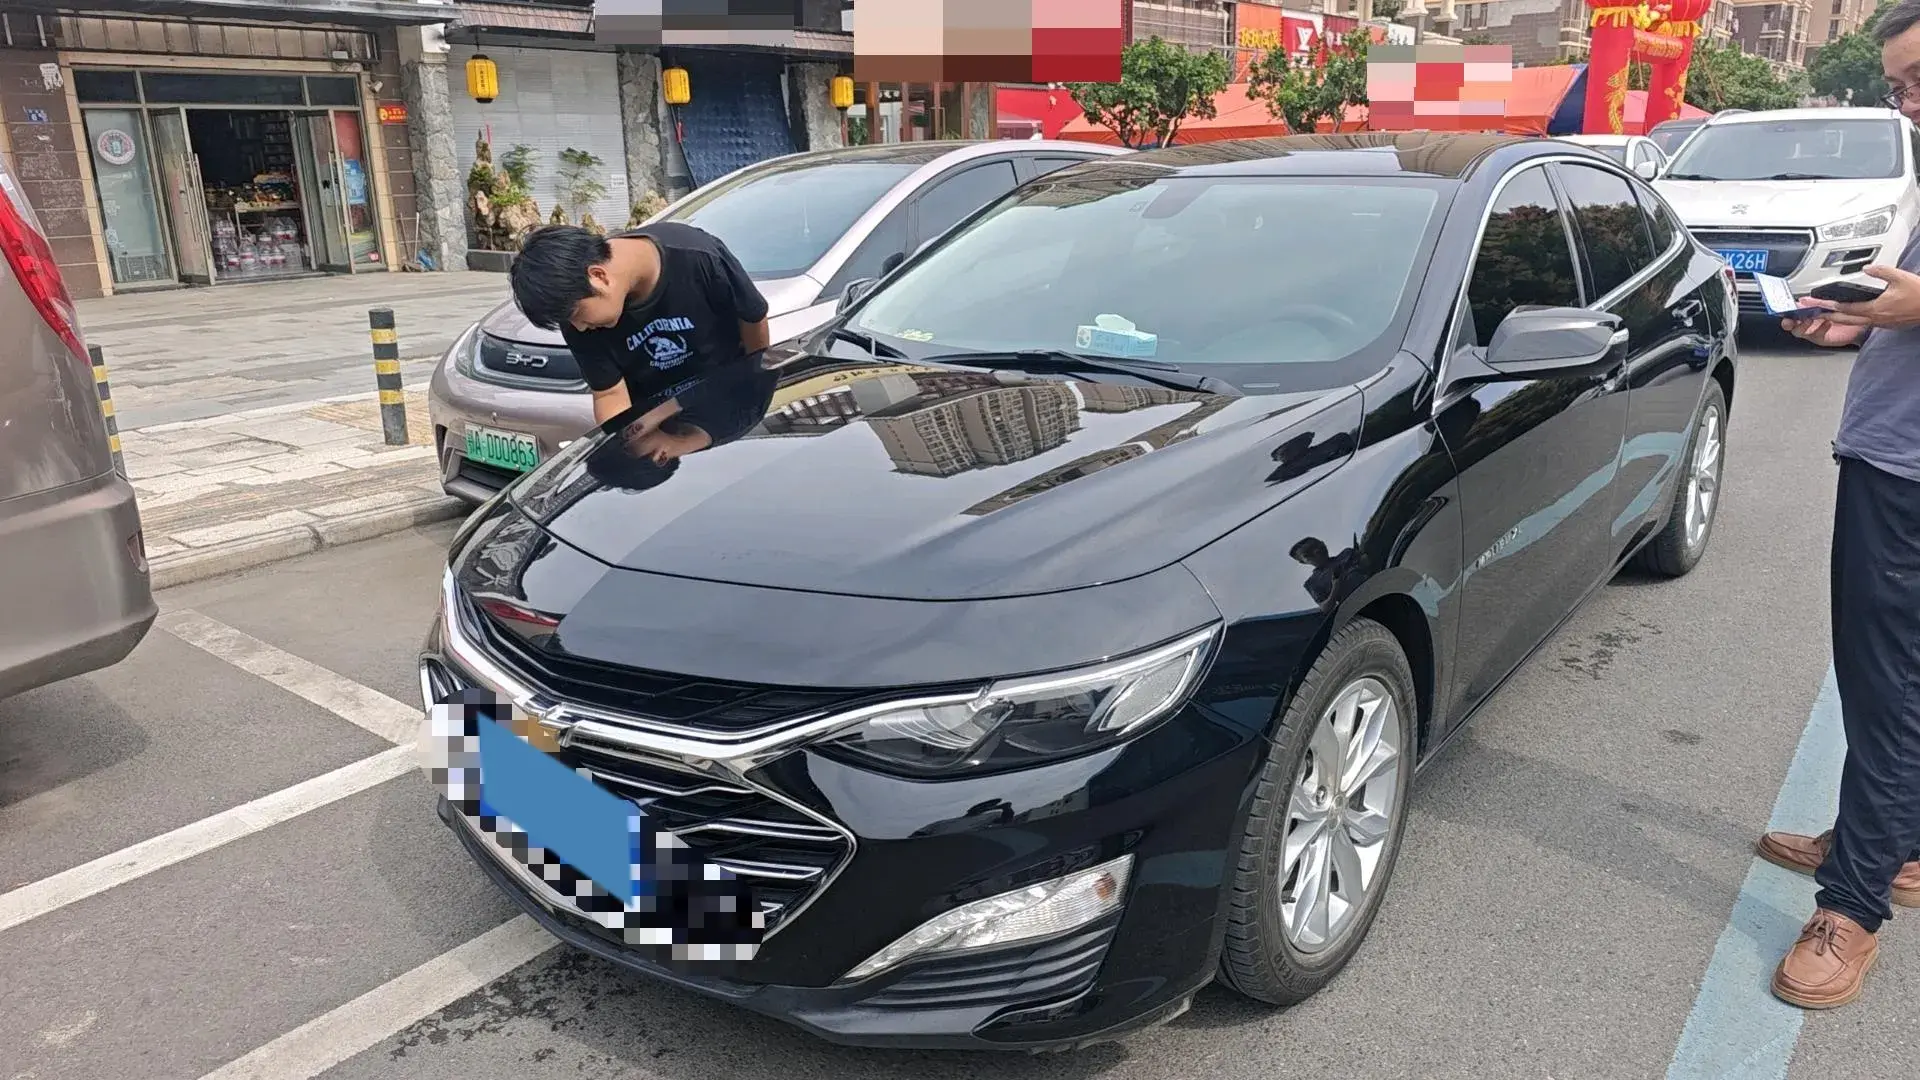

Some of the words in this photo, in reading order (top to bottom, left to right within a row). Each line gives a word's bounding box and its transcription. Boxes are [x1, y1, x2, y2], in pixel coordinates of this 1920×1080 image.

[1719, 252, 1766, 270] K26H
[626, 316, 695, 351] CALIFORNIA
[506, 352, 549, 368] BYD
